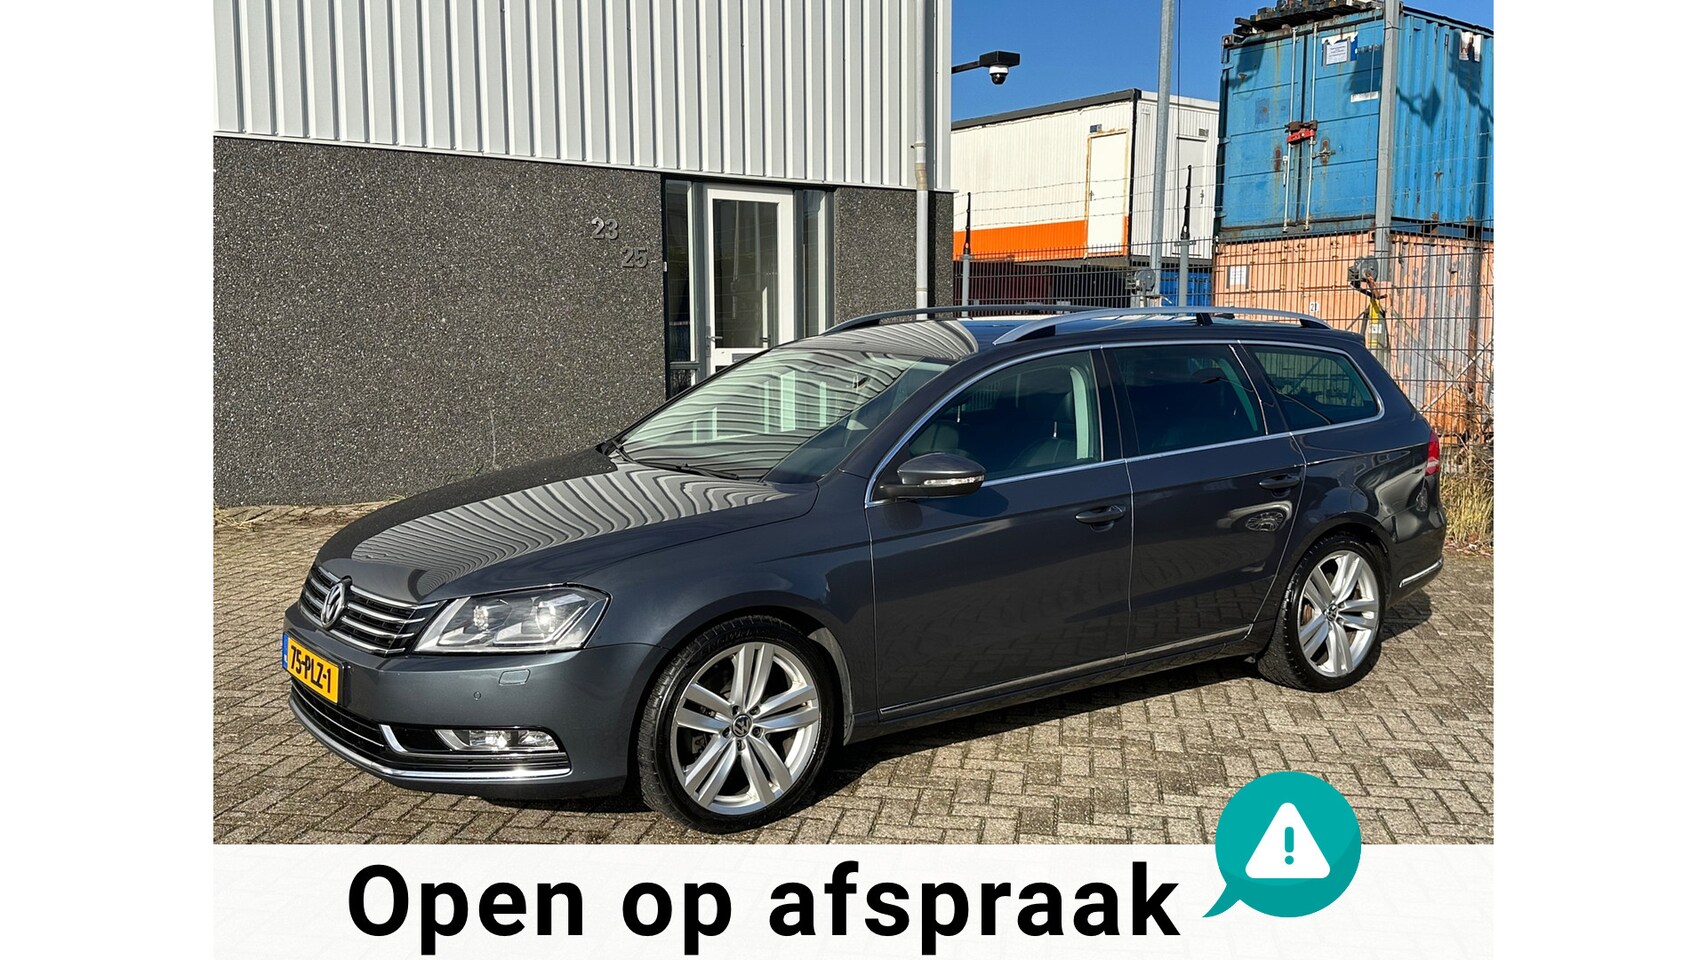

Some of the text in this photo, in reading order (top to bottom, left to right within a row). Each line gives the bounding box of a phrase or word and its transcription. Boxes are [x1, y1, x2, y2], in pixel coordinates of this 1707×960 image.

[591, 217, 618, 240] 23
[621, 246, 647, 268] 25
[290, 644, 332, 694] 75-PLZ-1
